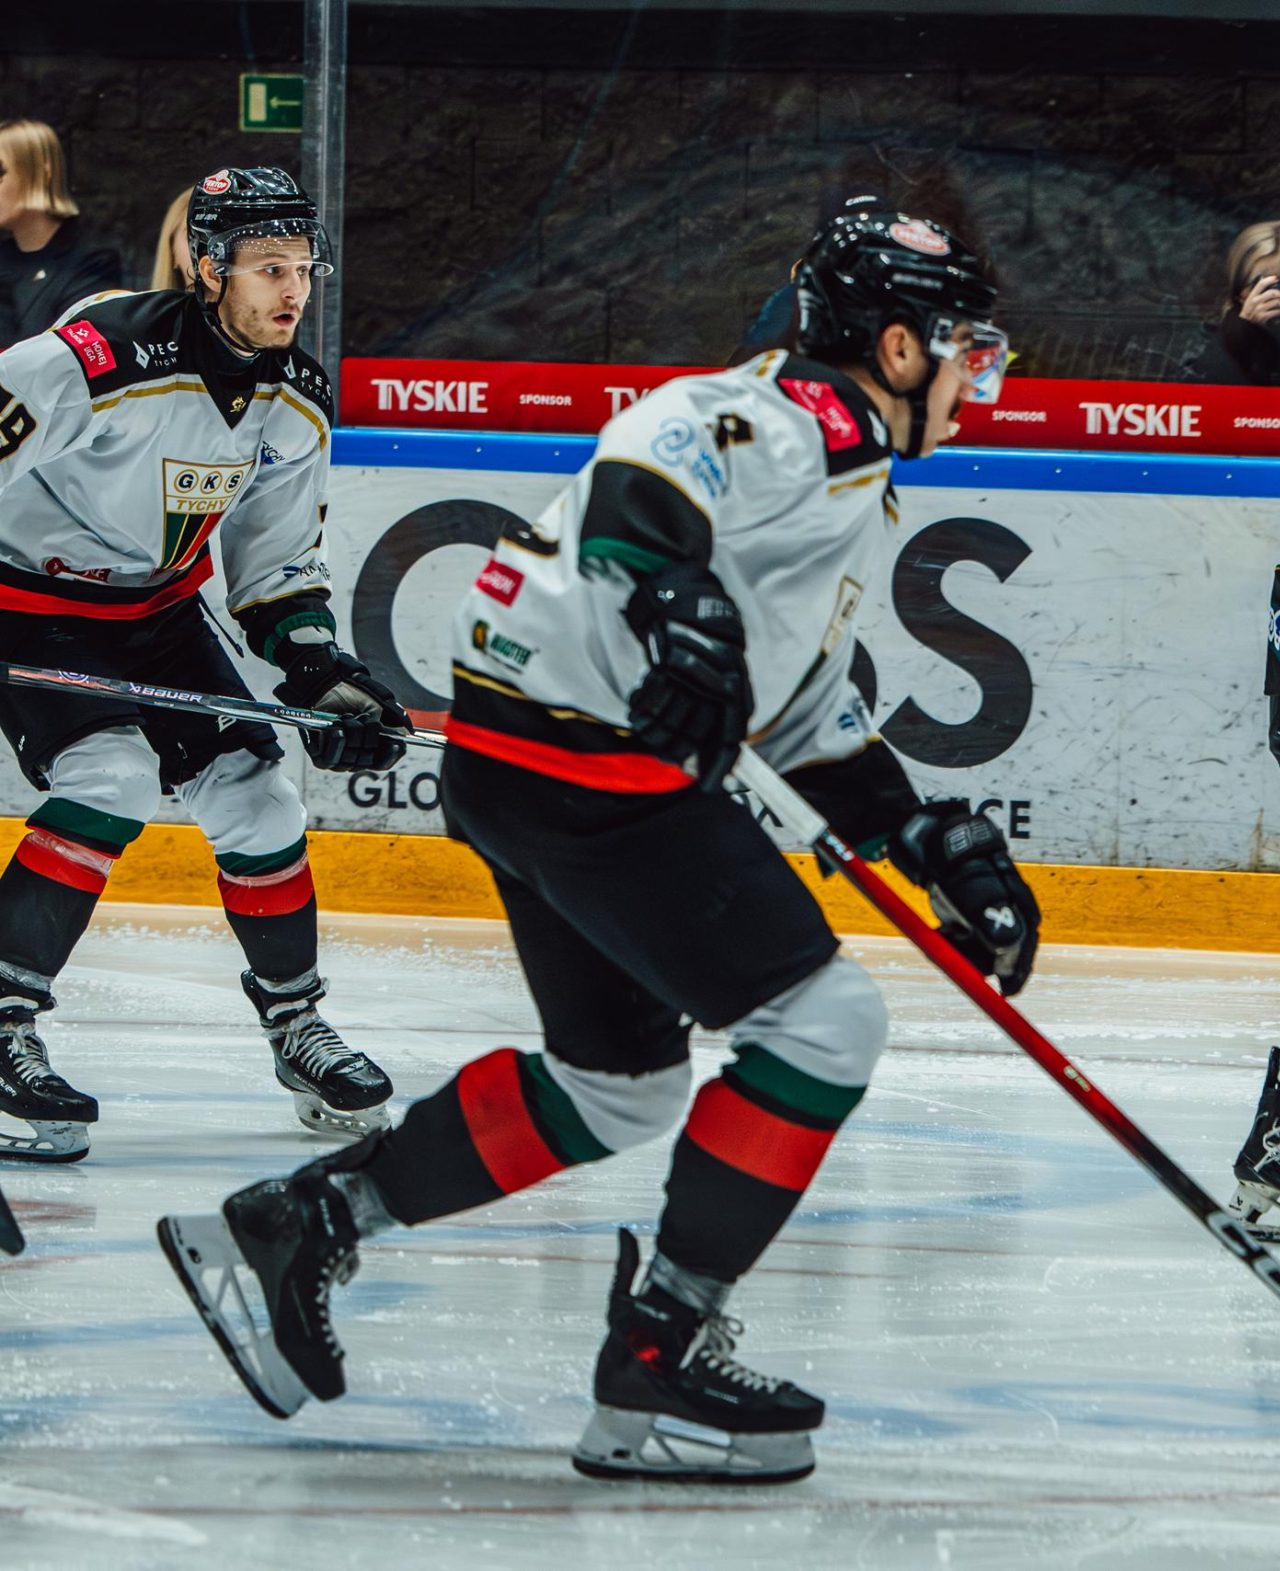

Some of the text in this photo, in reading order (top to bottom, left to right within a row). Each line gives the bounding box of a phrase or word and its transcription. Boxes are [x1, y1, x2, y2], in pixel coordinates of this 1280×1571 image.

[147, 341, 179, 356] PEC
[370, 379, 572, 414] TYSKIE SPONSOR
[992, 410, 1047, 423] SPONSOR
[1078, 402, 1202, 438] TYSKIE
[175, 498, 228, 512] TYCHY
[141, 687, 203, 704] BAUER
[348, 770, 443, 811] GLO
